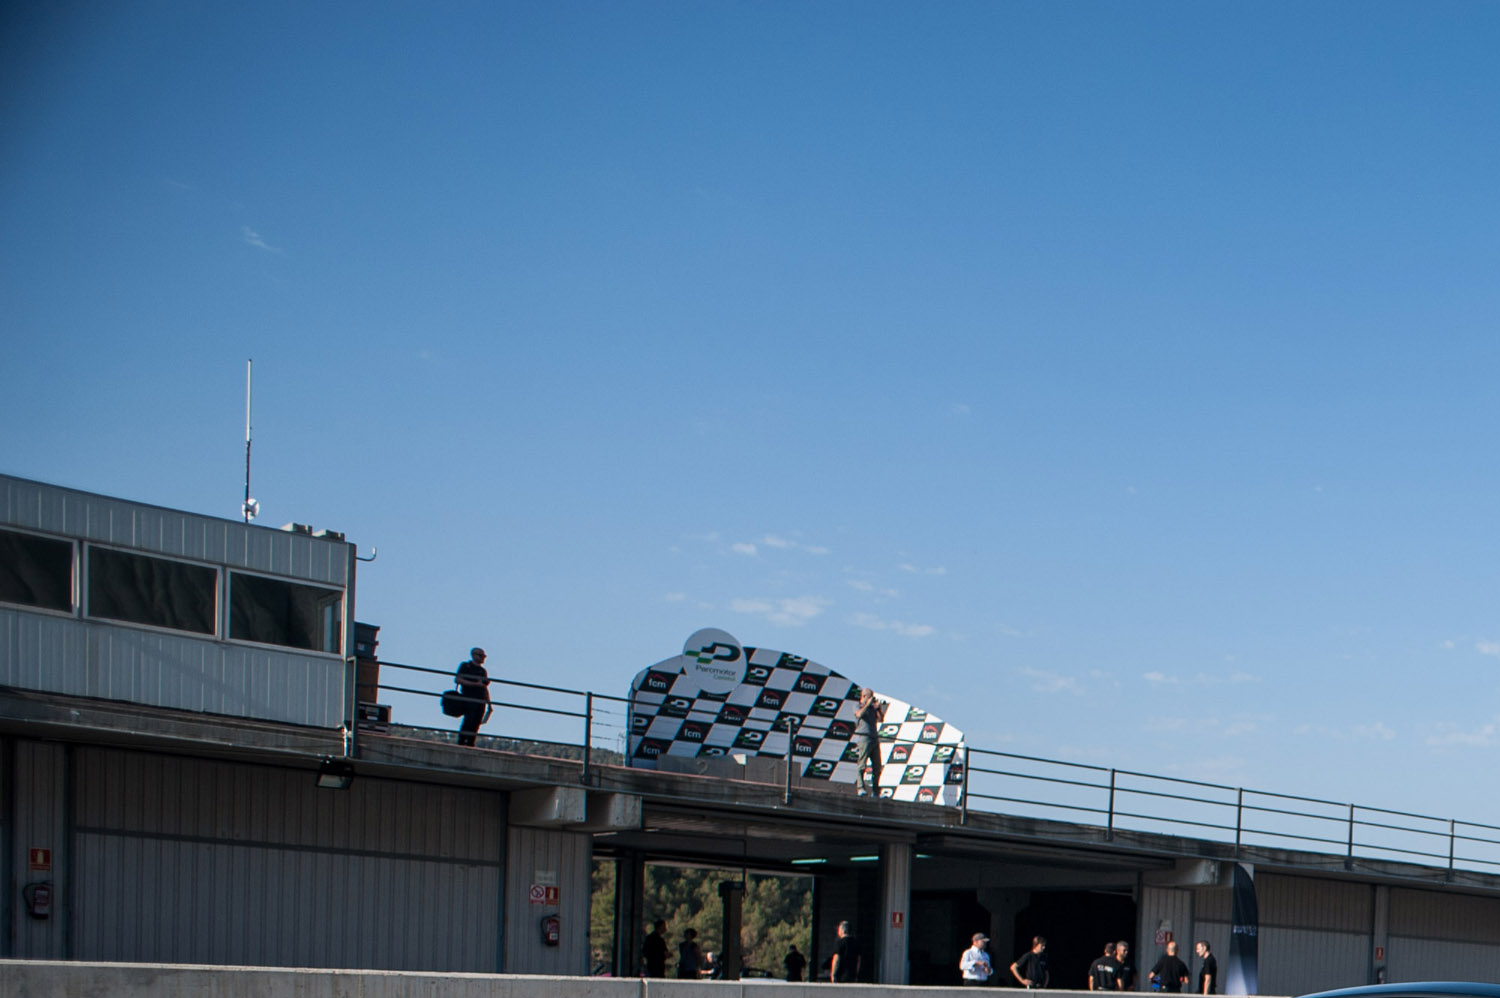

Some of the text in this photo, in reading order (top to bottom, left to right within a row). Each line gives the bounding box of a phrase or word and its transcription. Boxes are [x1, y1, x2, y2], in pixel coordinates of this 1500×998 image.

[648, 677, 666, 689] fcm
[800, 680, 816, 690] fcm
[763, 695, 779, 706] fcm
[684, 728, 702, 739] fcm
[795, 741, 812, 752] fcm
